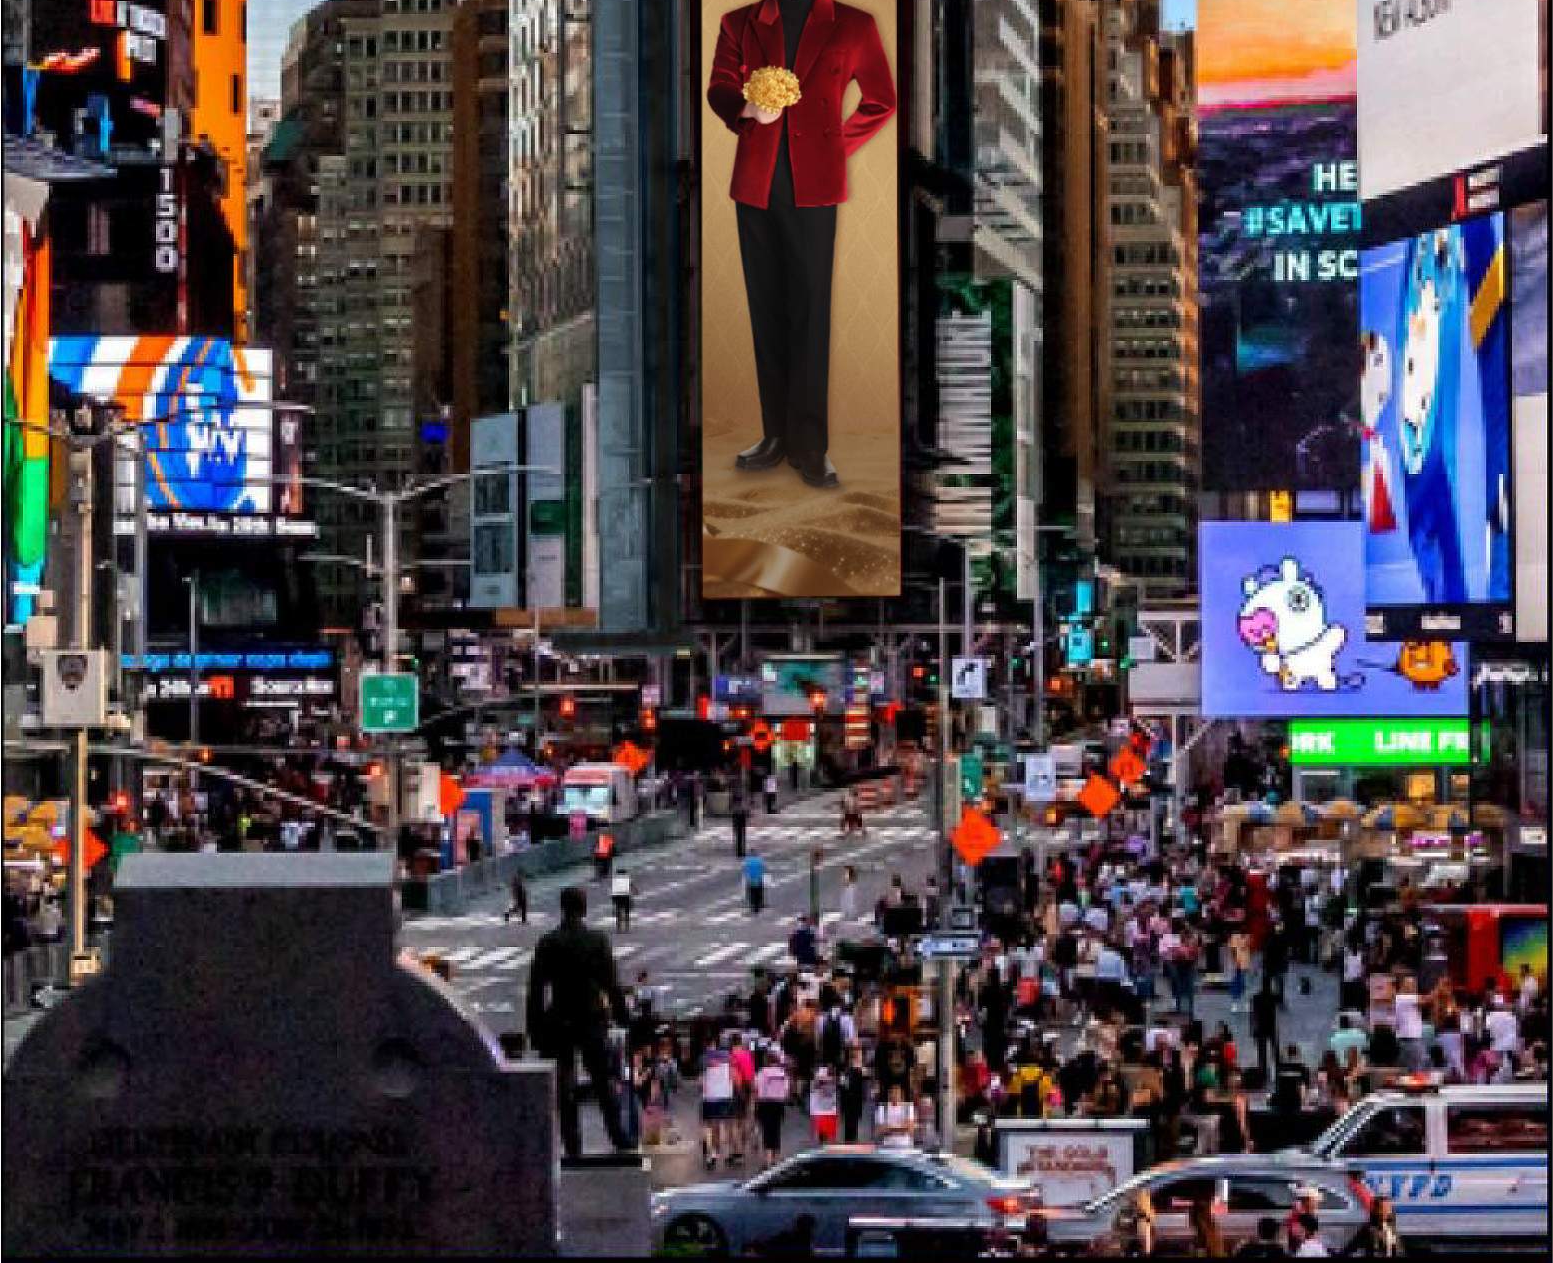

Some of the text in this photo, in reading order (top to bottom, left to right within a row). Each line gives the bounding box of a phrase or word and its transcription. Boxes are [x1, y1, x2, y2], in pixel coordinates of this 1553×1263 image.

[1313, 163, 1358, 191] HE
[156, 167, 178, 272] 1500
[1274, 249, 1358, 281] IN SC
